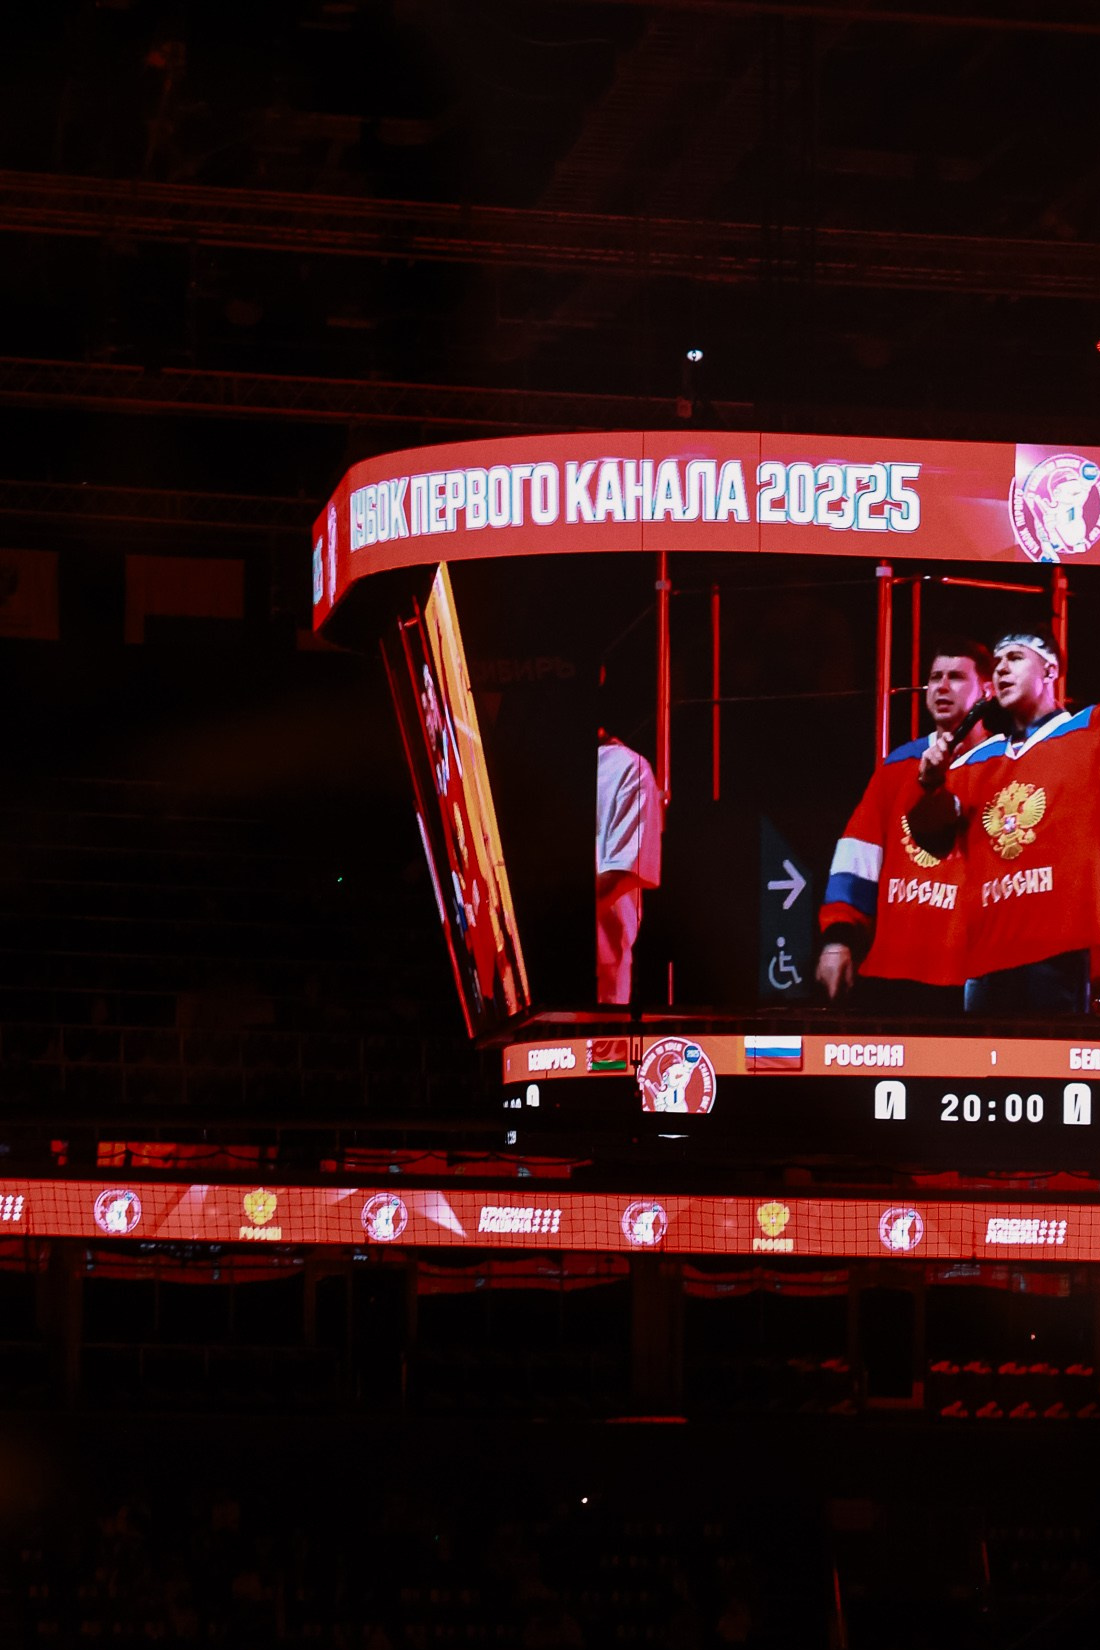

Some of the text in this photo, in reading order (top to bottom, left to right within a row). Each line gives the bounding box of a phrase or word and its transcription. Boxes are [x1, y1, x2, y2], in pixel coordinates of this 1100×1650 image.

[410, 462, 560, 536] ПЕРВОГО
[566, 459, 750, 523] КАНАЛА
[887, 878, 959, 910] РОССИЯ
[982, 866, 1053, 907] РОССИЯ
[824, 1043, 904, 1067] РОССИЯ
[940, 1093, 1044, 1122] 20:00
